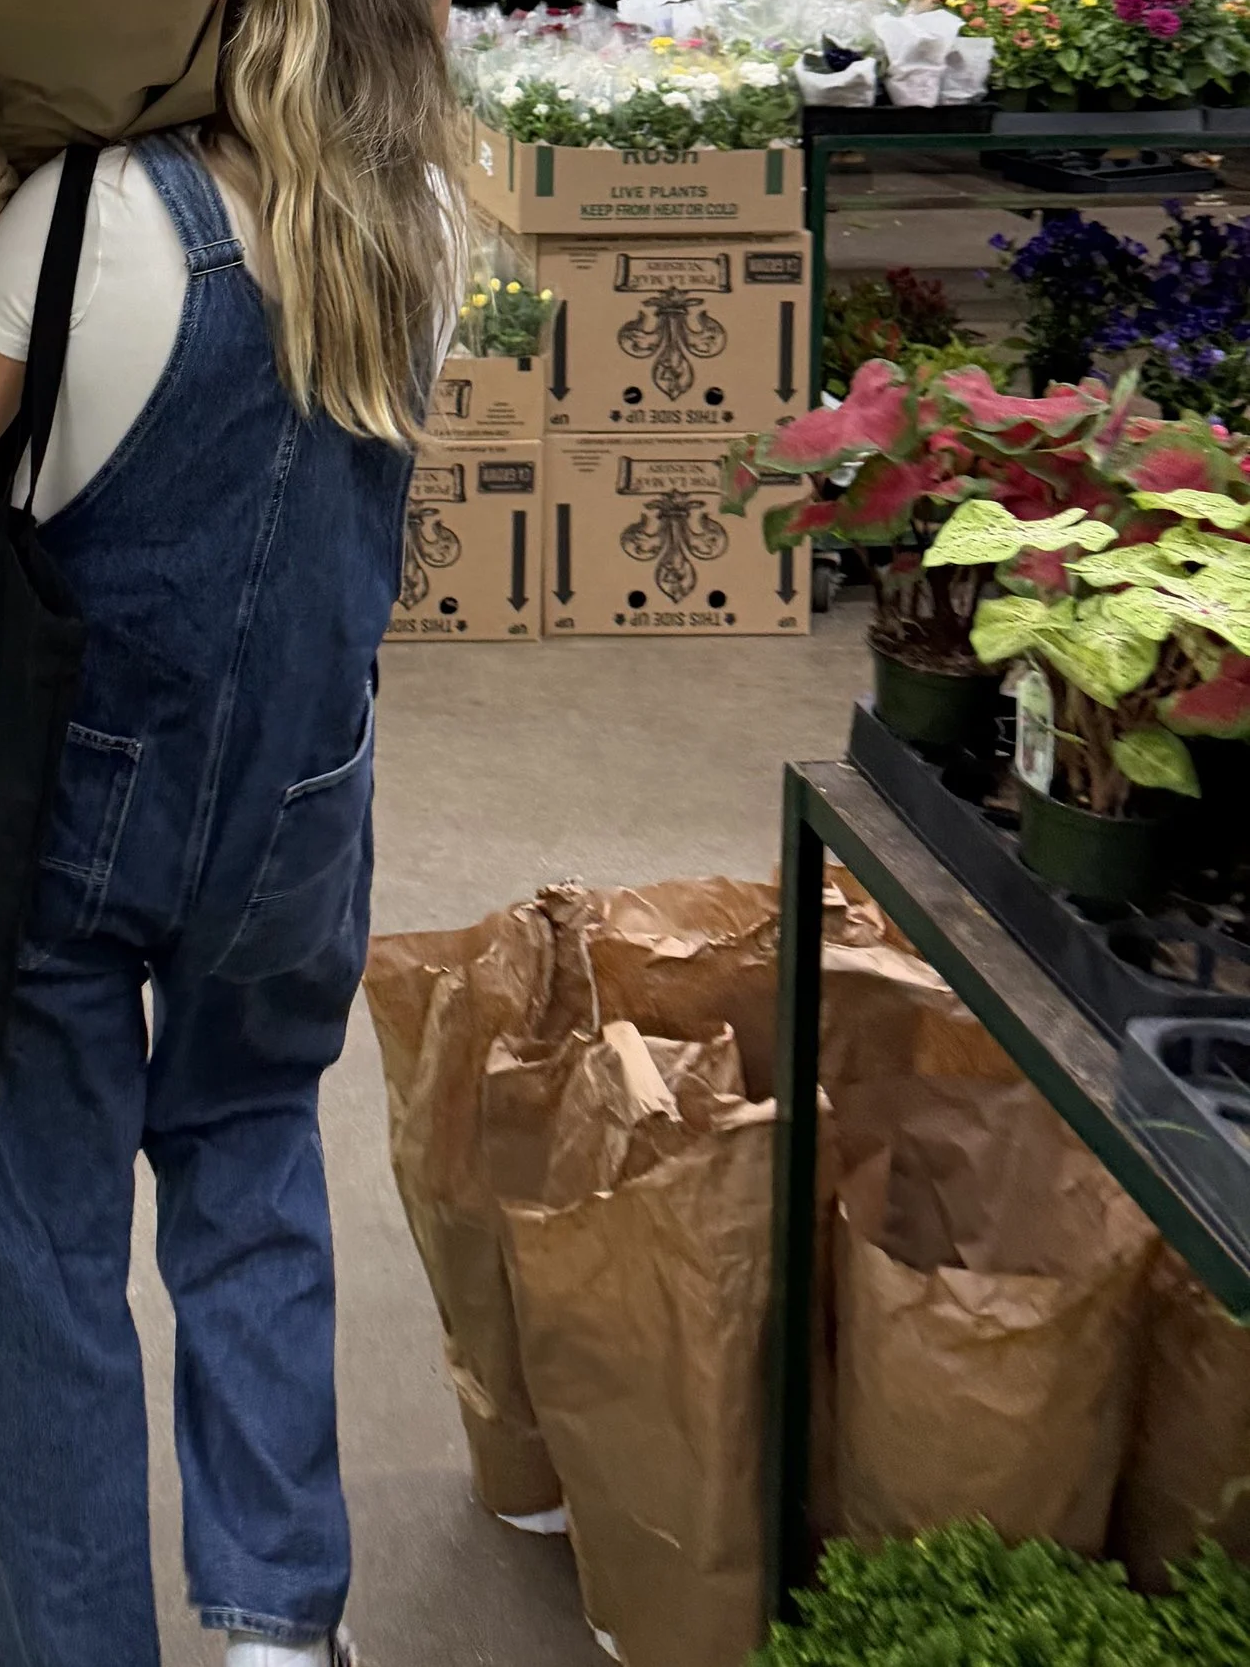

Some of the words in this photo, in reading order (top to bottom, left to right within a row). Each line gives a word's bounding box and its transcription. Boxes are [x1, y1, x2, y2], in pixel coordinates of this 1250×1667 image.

[610, 186, 644, 199] LIVE
[649, 185, 709, 198] PLANTS
[580, 204, 613, 217] KEEP
[616, 203, 650, 216] FROM
[653, 203, 686, 216] HEAT
[686, 203, 704, 216] OR
[706, 203, 738, 216] COLD
[625, 410, 645, 424] UP
[649, 410, 682, 424] SIDE
[686, 410, 719, 424] THIS
[392, 619, 417, 633] SID
[421, 619, 454, 633] THIS
[629, 612, 649, 627] UP
[653, 612, 686, 627] SIDE
[689, 612, 721, 627] THIS
